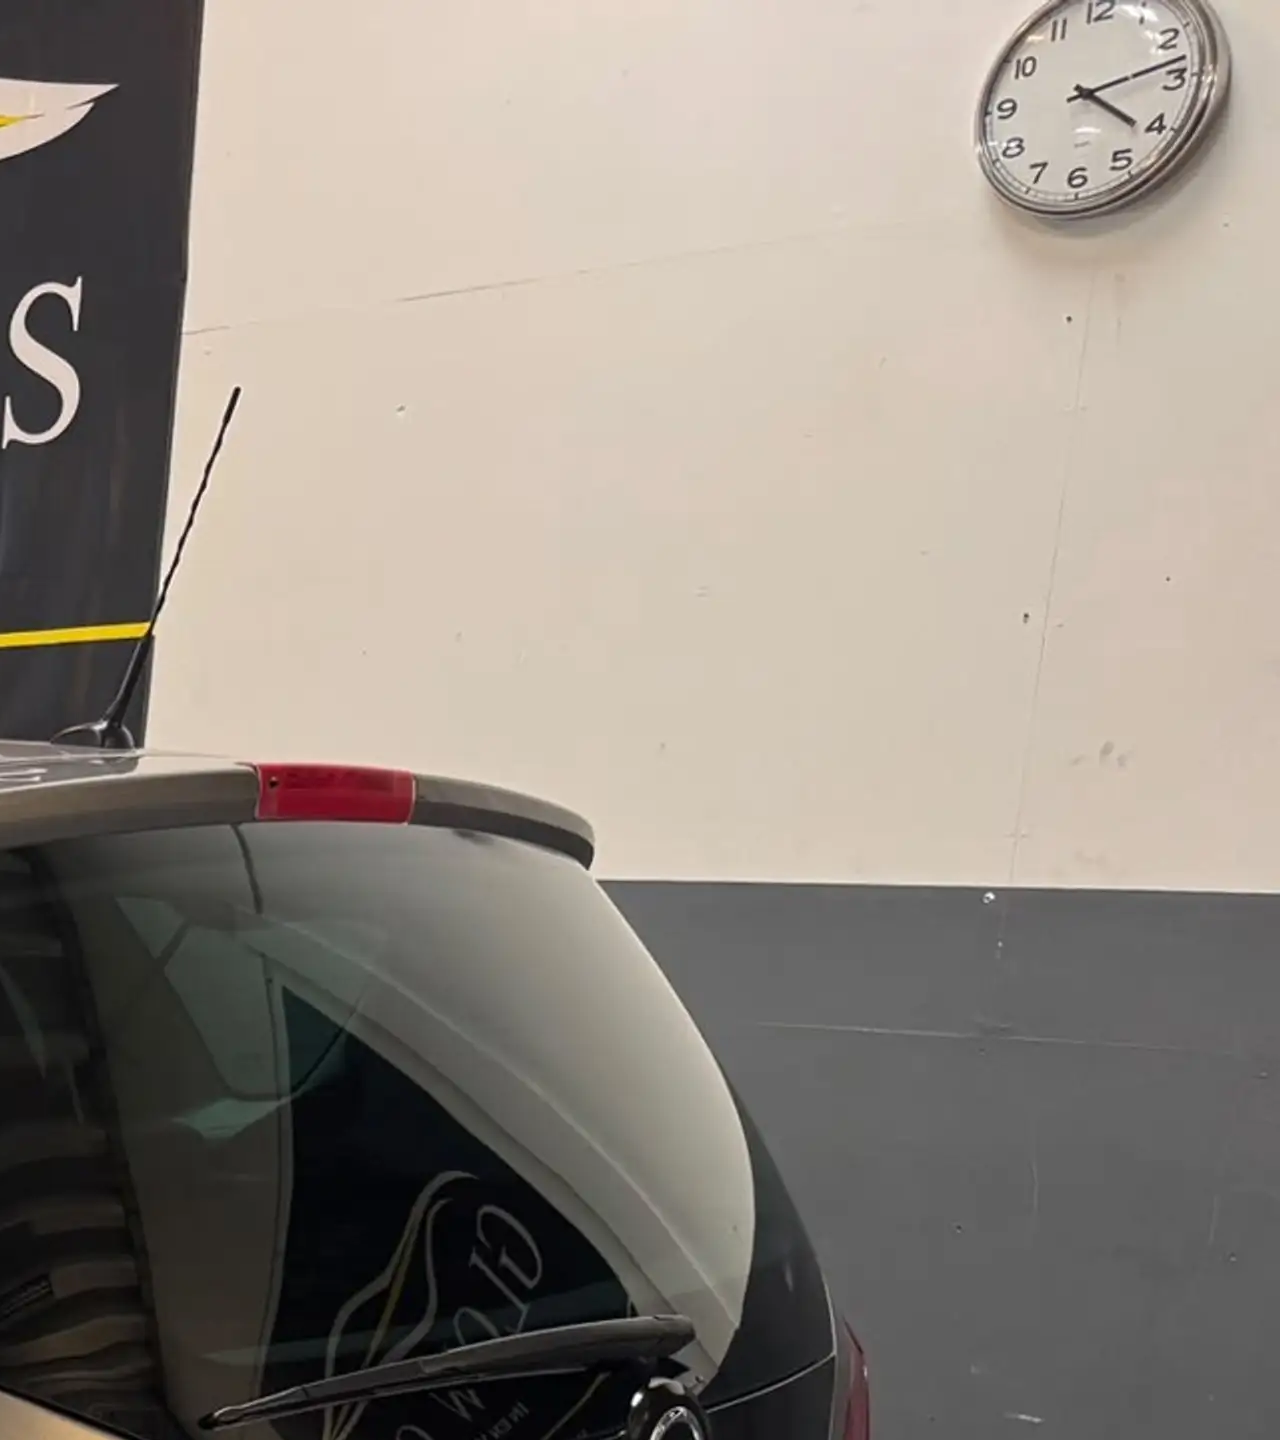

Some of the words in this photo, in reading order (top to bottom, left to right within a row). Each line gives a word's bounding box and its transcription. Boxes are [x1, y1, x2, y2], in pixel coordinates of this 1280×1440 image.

[1086, 0, 1115, 25] 12
[1050, 18, 1068, 42] 11
[1157, 28, 1180, 51] 2
[1014, 56, 1037, 80] 10
[1162, 67, 1187, 92] 3
[996, 98, 1018, 120] 9
[1144, 113, 1167, 136] 4
[1001, 137, 1024, 159] 8
[1109, 149, 1133, 172] 5
[1029, 161, 1049, 185] 7
[1066, 167, 1088, 189] 6
